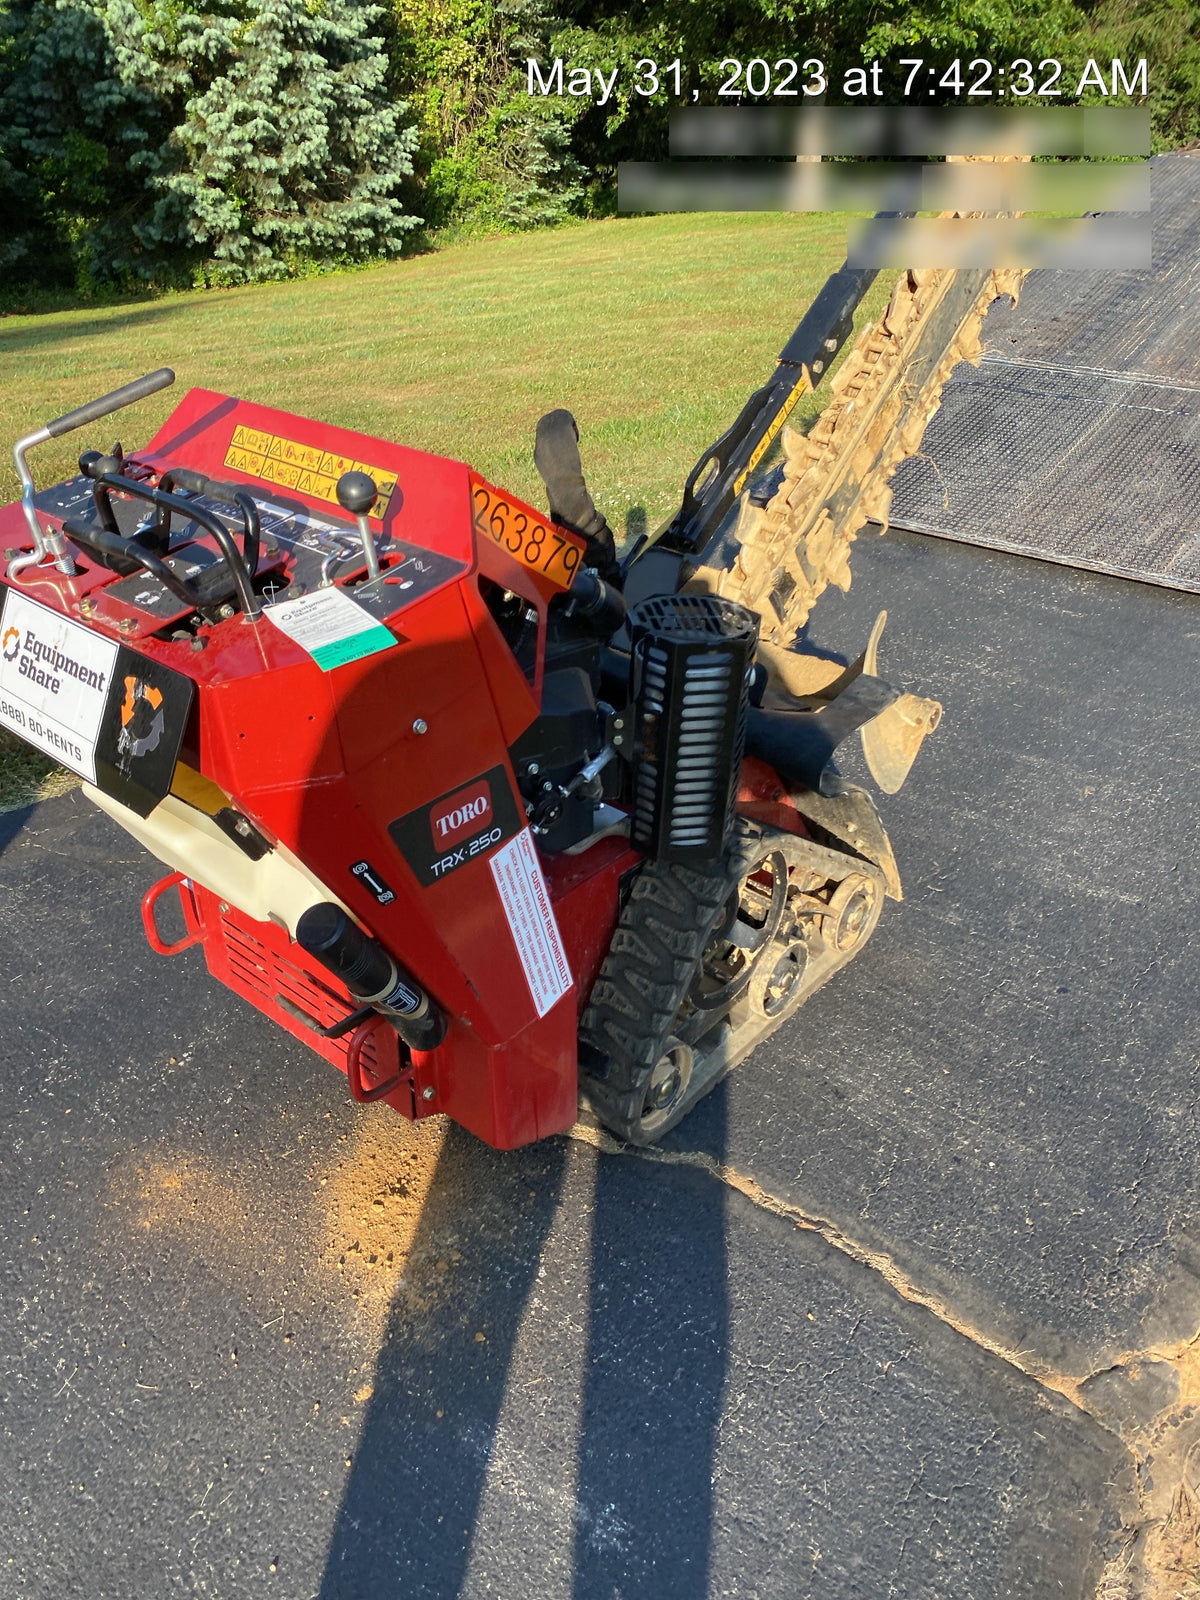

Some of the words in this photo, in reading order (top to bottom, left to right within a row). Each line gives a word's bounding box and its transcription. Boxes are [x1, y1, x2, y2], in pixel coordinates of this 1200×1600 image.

[474, 489, 580, 585] 263879
[18, 655, 62, 695] Share
[23, 630, 106, 693] Equipment
[28, 717, 82, 762] 80-RENTS
[436, 796, 488, 836] TORO
[530, 868, 549, 920] CUSTOMER
[545, 918, 569, 990] RESPONSIBILITY
